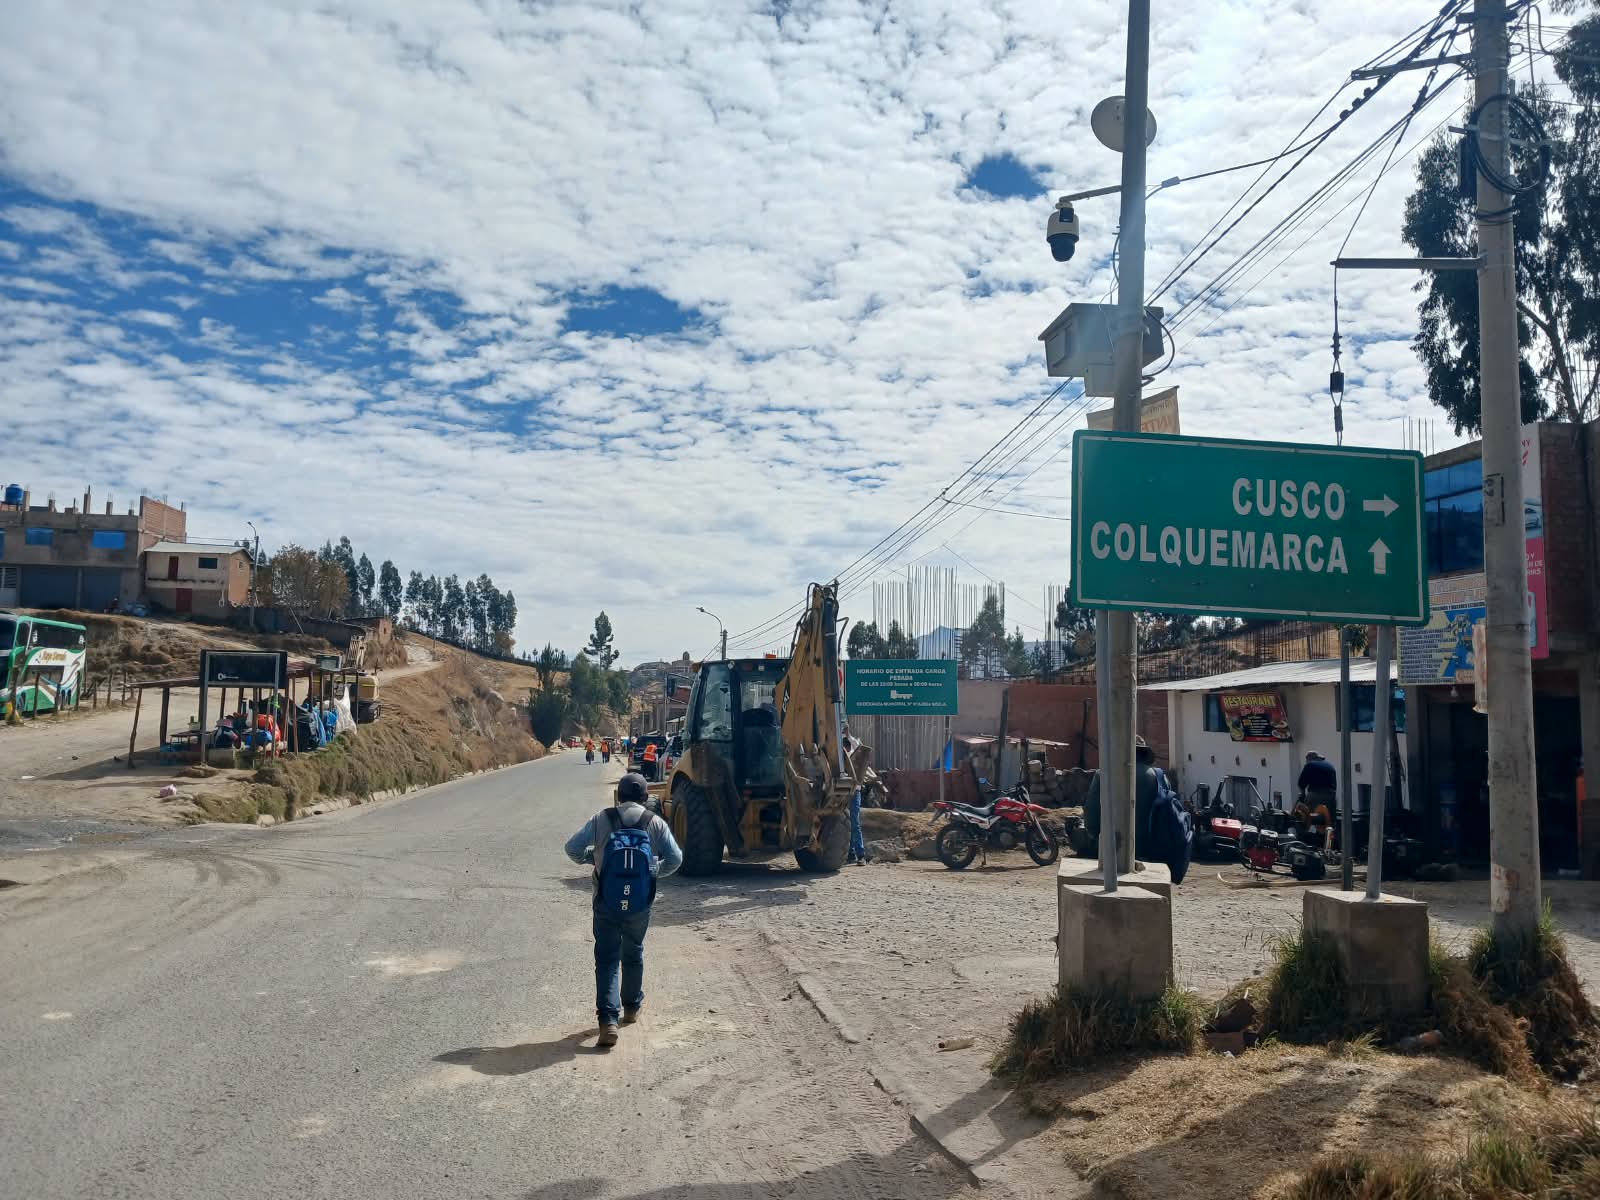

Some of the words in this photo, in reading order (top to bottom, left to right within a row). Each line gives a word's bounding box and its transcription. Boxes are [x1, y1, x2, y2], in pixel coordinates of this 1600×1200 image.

[1232, 477, 1345, 521] CUSCO
[1090, 520, 1349, 574] COLQUEMARCA
[1223, 695, 1276, 707] RESTAURANT
